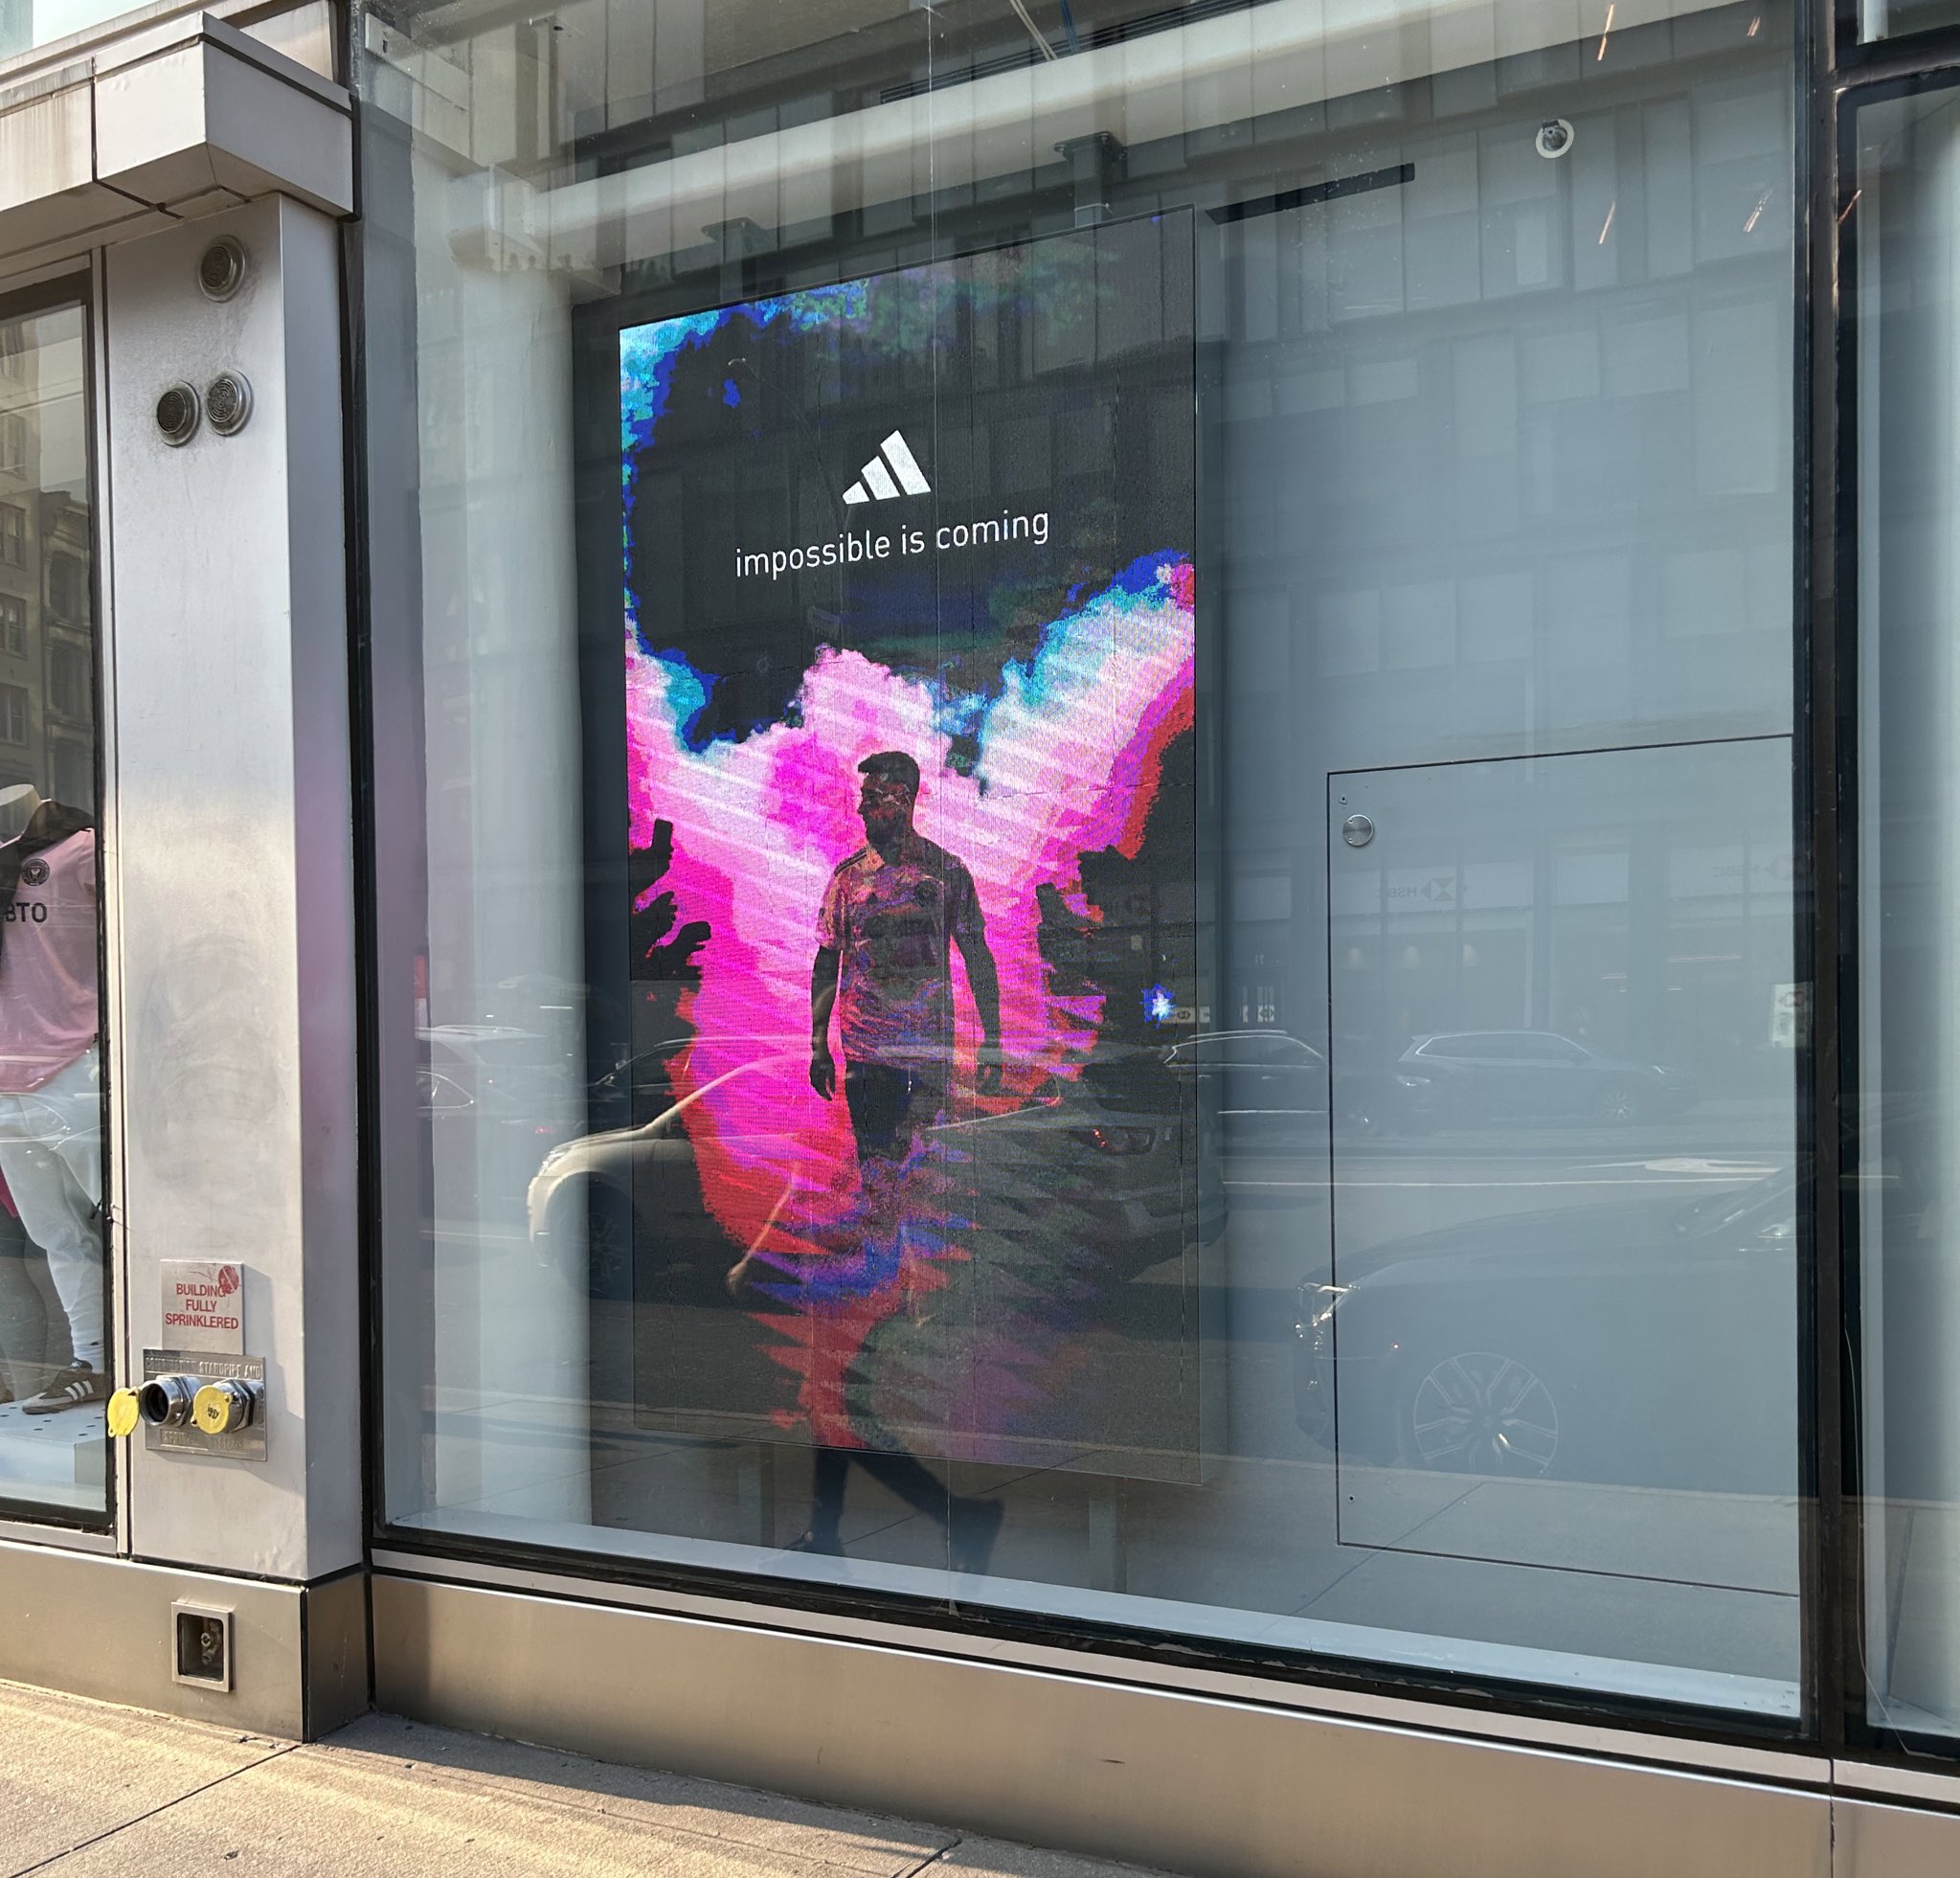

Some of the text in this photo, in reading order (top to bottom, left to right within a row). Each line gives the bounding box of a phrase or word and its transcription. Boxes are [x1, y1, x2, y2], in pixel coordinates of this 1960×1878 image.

[735, 509, 1049, 580] impossible is coming
[176, 1283, 226, 1298] BUILDING
[186, 1299, 217, 1313] FULLY
[165, 1313, 239, 1330] SPRINKLERED
